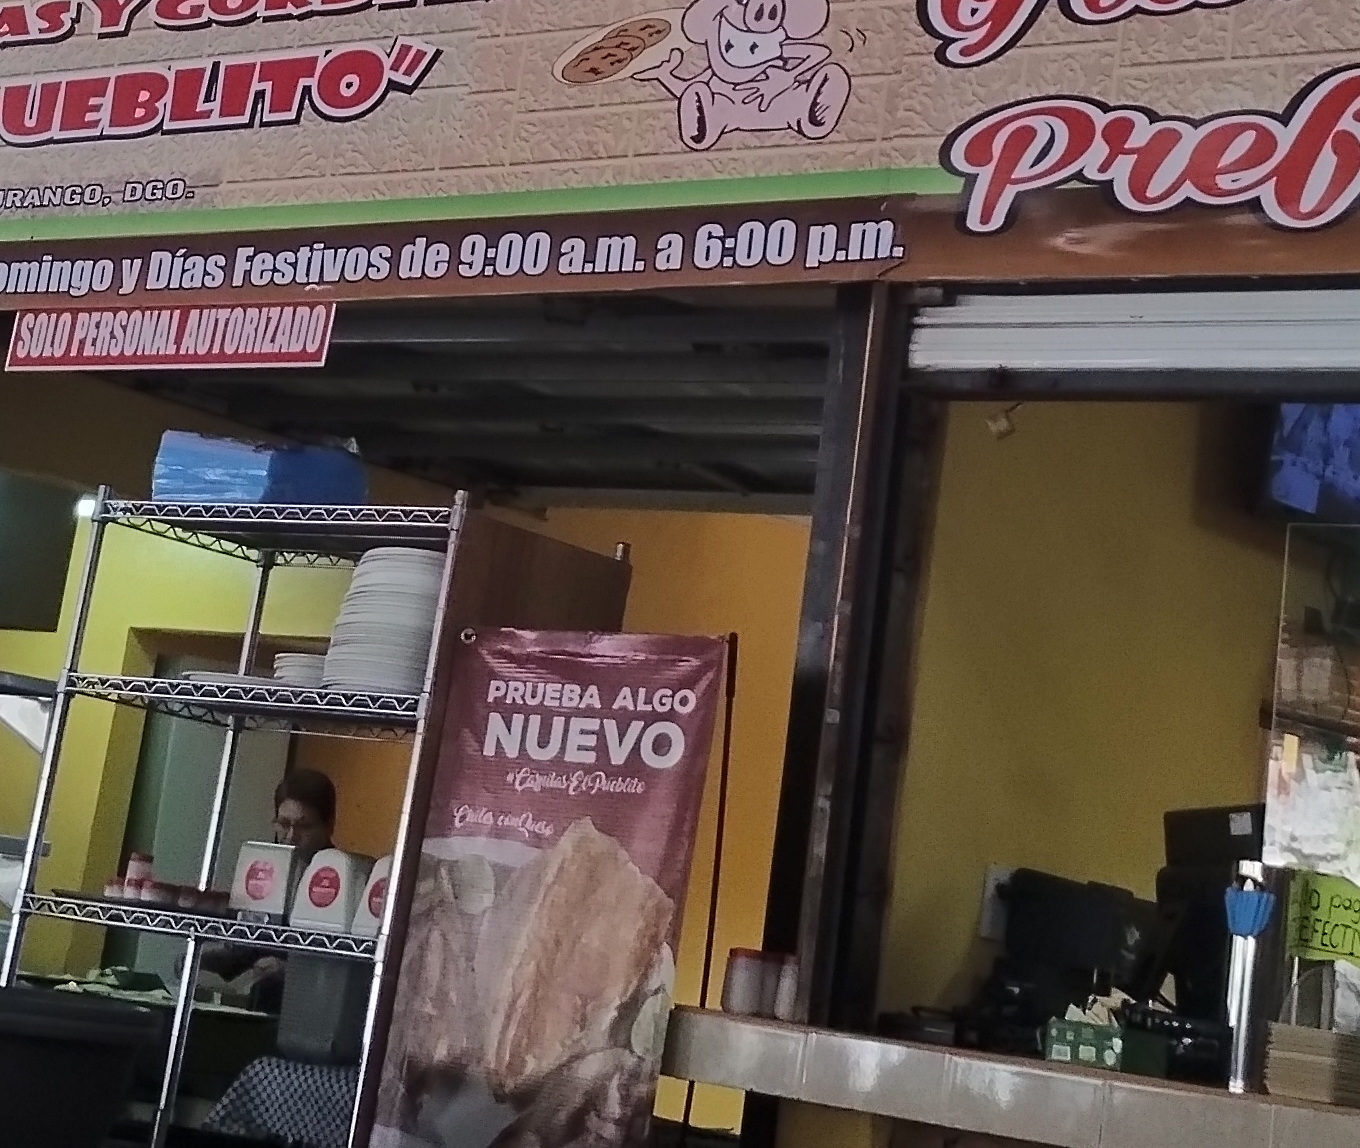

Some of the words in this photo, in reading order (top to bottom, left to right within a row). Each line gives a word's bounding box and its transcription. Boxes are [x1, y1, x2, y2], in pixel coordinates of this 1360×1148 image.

[122, 178, 195, 204] DGO.
[118, 257, 144, 295] y
[145, 248, 227, 291] Días
[231, 241, 394, 288] Festivos
[396, 236, 451, 280] de
[457, 230, 553, 278] 9:00
[557, 234, 647, 275] a.m.
[654, 231, 684, 271] a
[692, 218, 798, 270] 6:00
[804, 218, 906, 270] p.m.
[16, 312, 72, 358] SOLO
[70, 308, 180, 357] PERSONAL
[179, 304, 327, 355] AUTORIZADO
[487, 679, 601, 710] PRUEBA
[612, 685, 697, 715] ALGO
[481, 712, 686, 770] NUEVO
